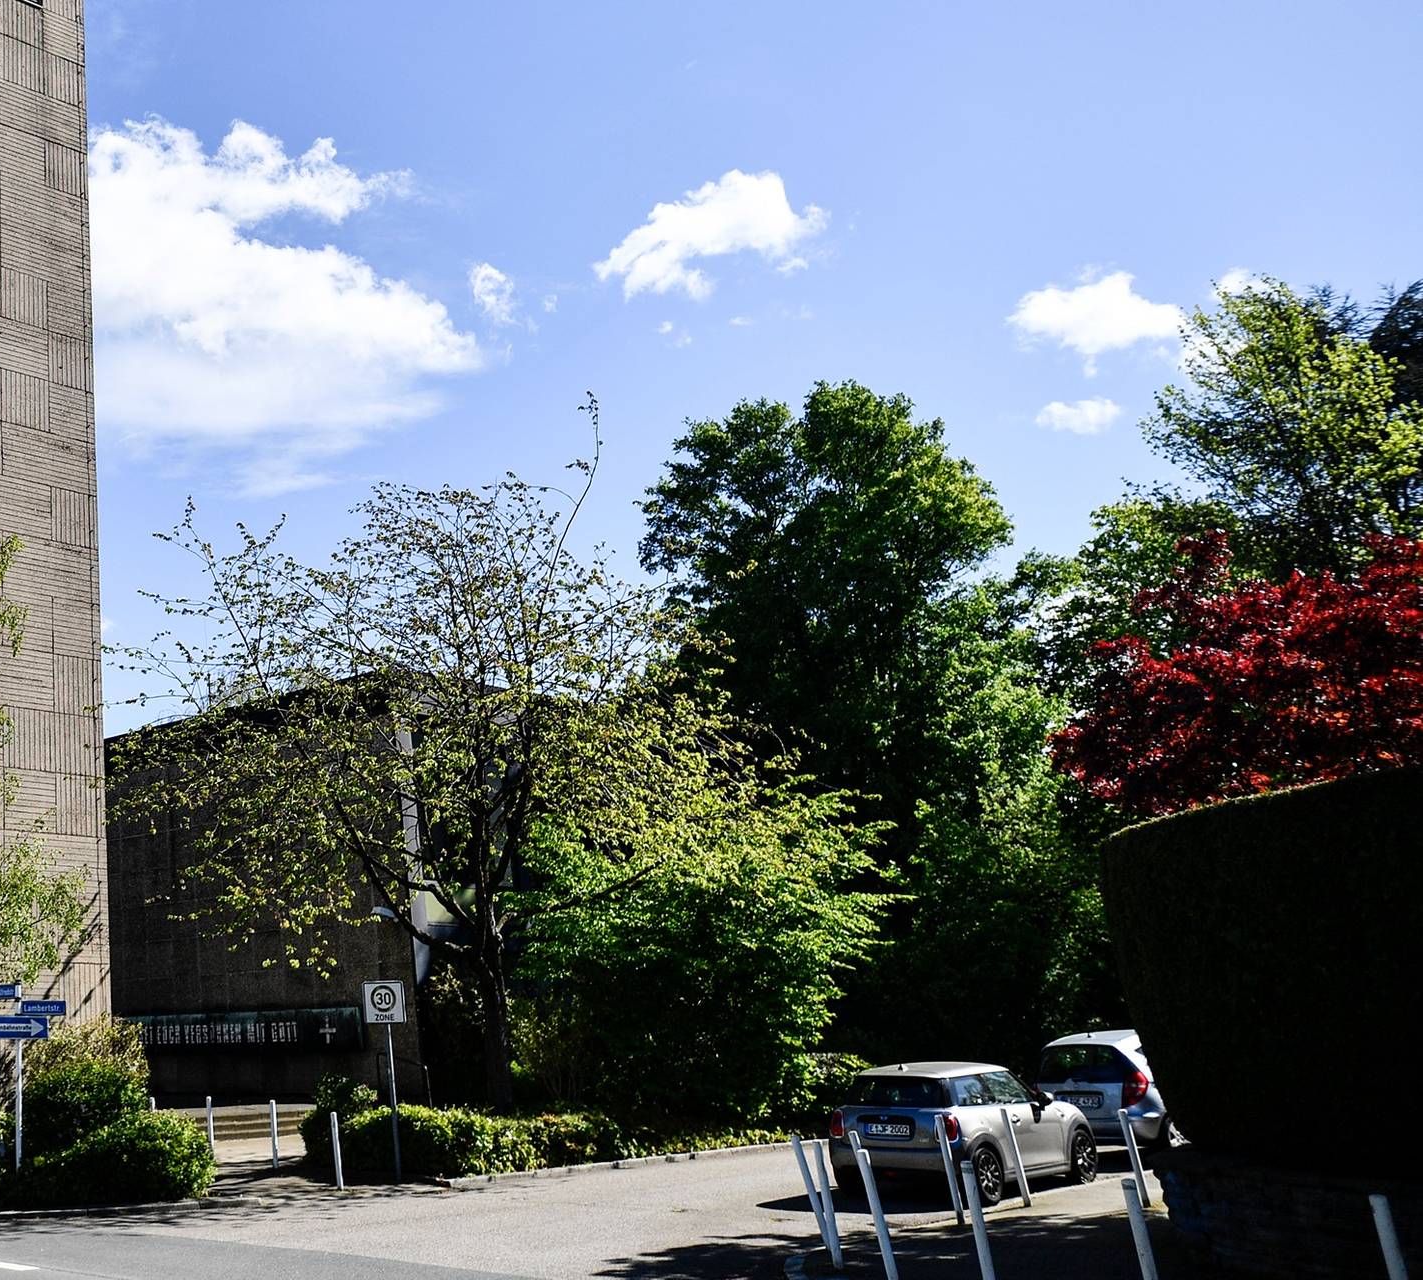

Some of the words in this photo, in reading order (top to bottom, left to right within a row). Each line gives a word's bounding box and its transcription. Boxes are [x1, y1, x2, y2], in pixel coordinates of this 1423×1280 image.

[376, 992, 392, 1006] 30
[23, 1004, 62, 1013] Lambertstr.
[374, 1013, 396, 1021] ZONE
[247, 1022, 265, 1044] MIT
[271, 1021, 298, 1043] GOTT
[890, 1125, 908, 1134] 2002
